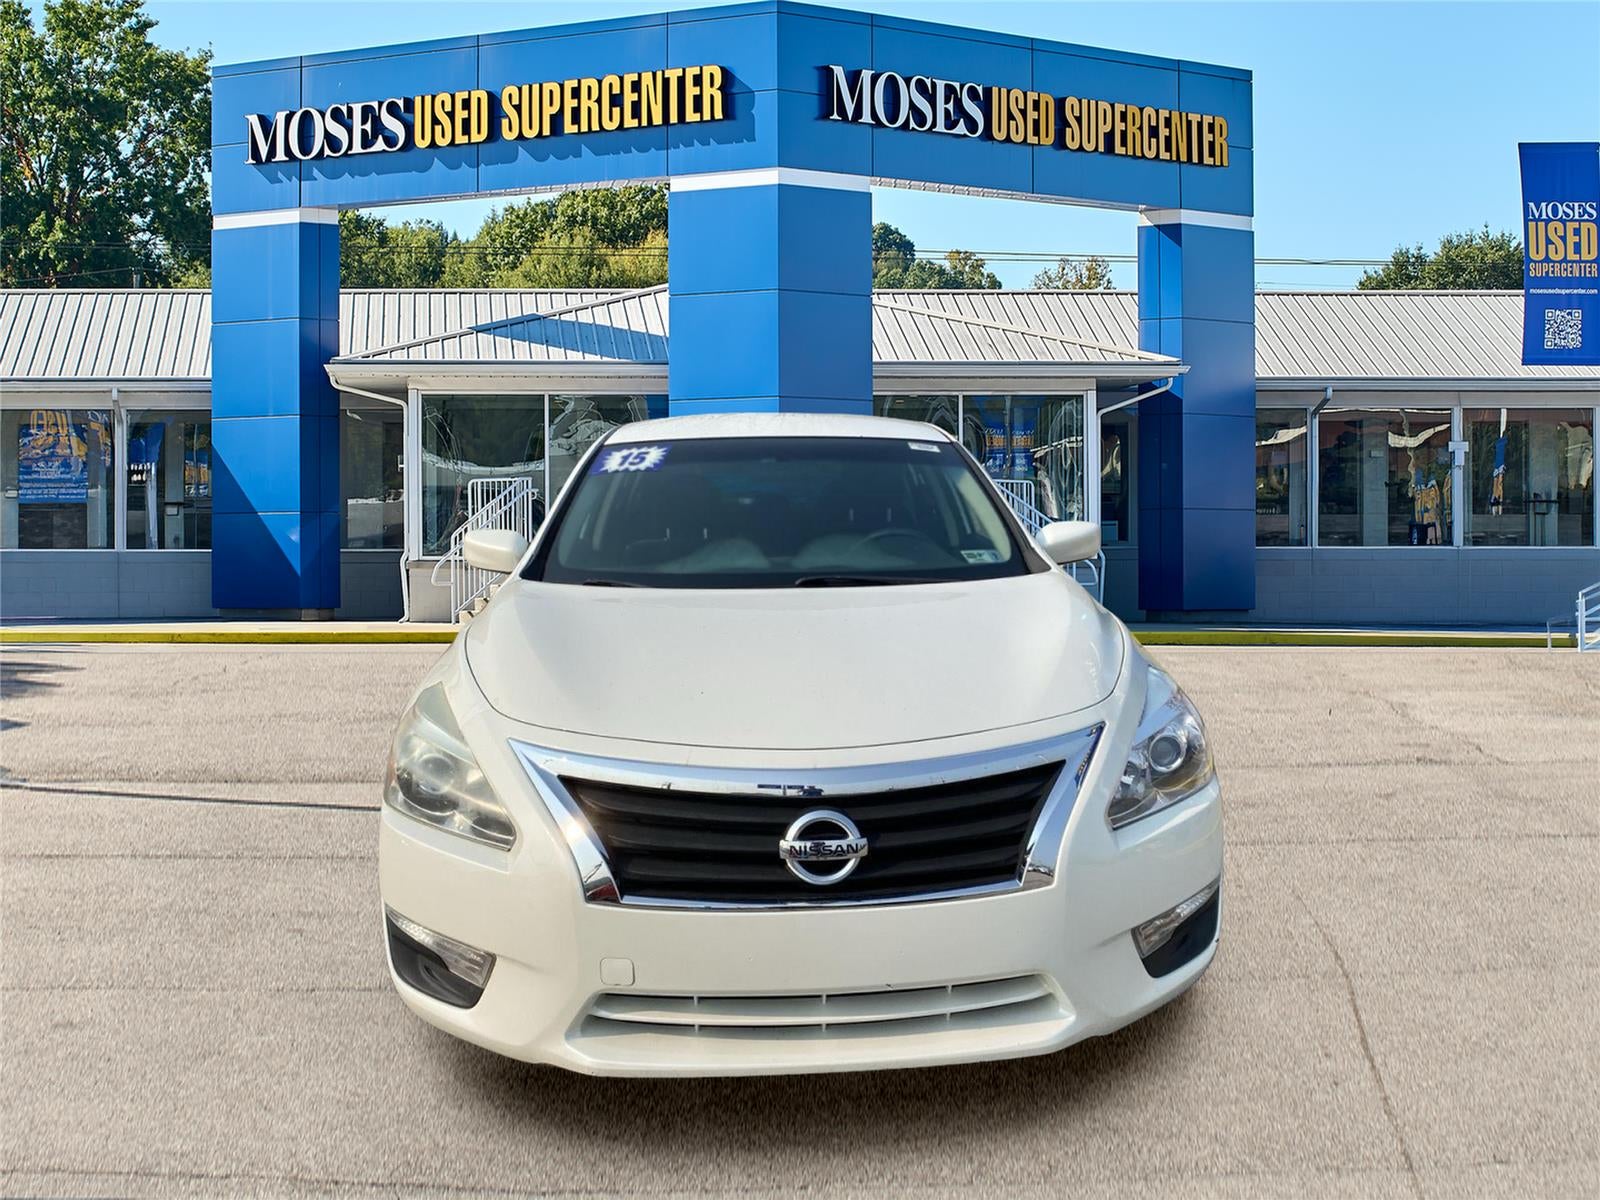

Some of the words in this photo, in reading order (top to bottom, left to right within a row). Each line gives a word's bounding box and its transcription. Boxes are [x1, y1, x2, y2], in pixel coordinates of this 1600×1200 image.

[244, 98, 407, 165] MOSES
[413, 88, 489, 150] USED
[500, 64, 725, 141] SUPERCENTER
[828, 64, 985, 138] MOSES
[990, 86, 1055, 146] USED
[1064, 95, 1230, 167] SUPERCENTER
[1527, 201, 1598, 220] MOSES
[1528, 221, 1599, 262] USED
[1529, 262, 1598, 278] SUPERCENTER
[788, 842, 859, 858] NISSAN
